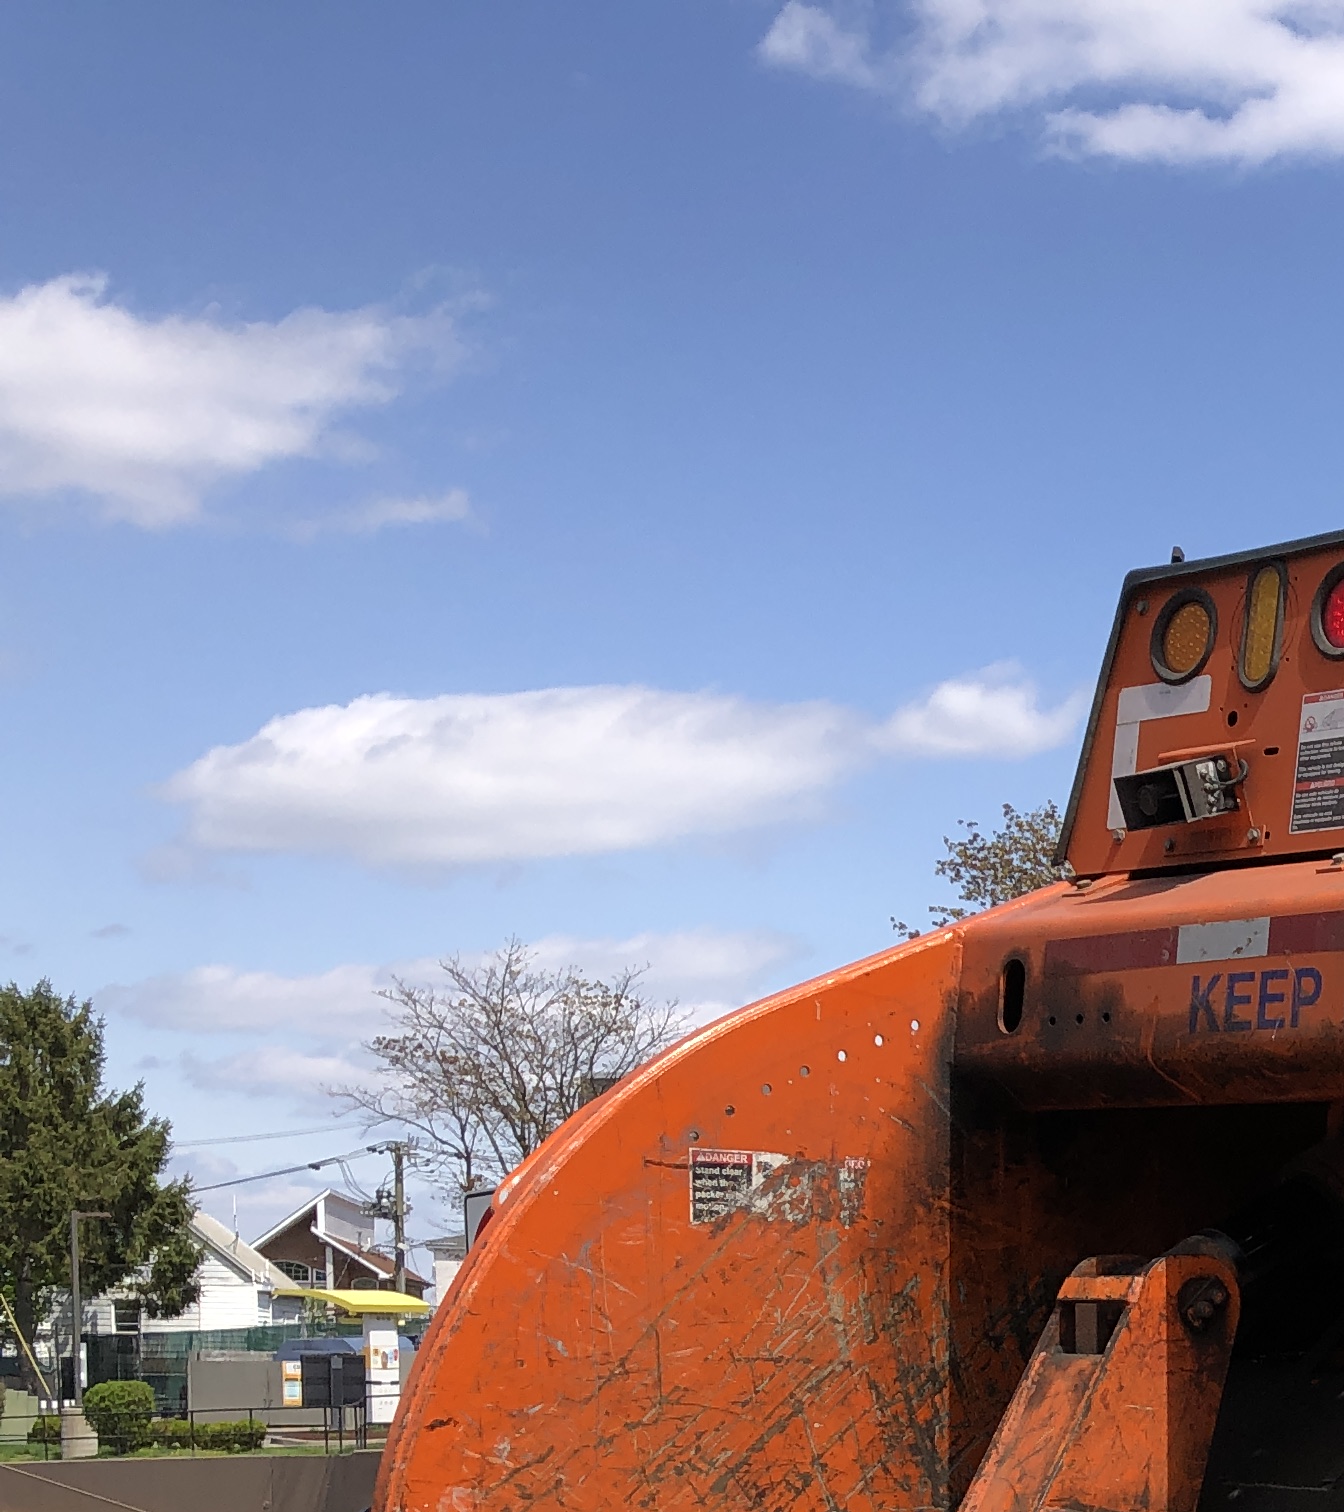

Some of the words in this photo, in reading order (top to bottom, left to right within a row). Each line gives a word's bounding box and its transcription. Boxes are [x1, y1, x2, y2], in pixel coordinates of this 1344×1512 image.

[1189, 966, 1323, 1035] KEEP
[705, 1153, 748, 1163] DANGER
[695, 1166, 720, 1175] Stand
[722, 1166, 743, 1175] clear
